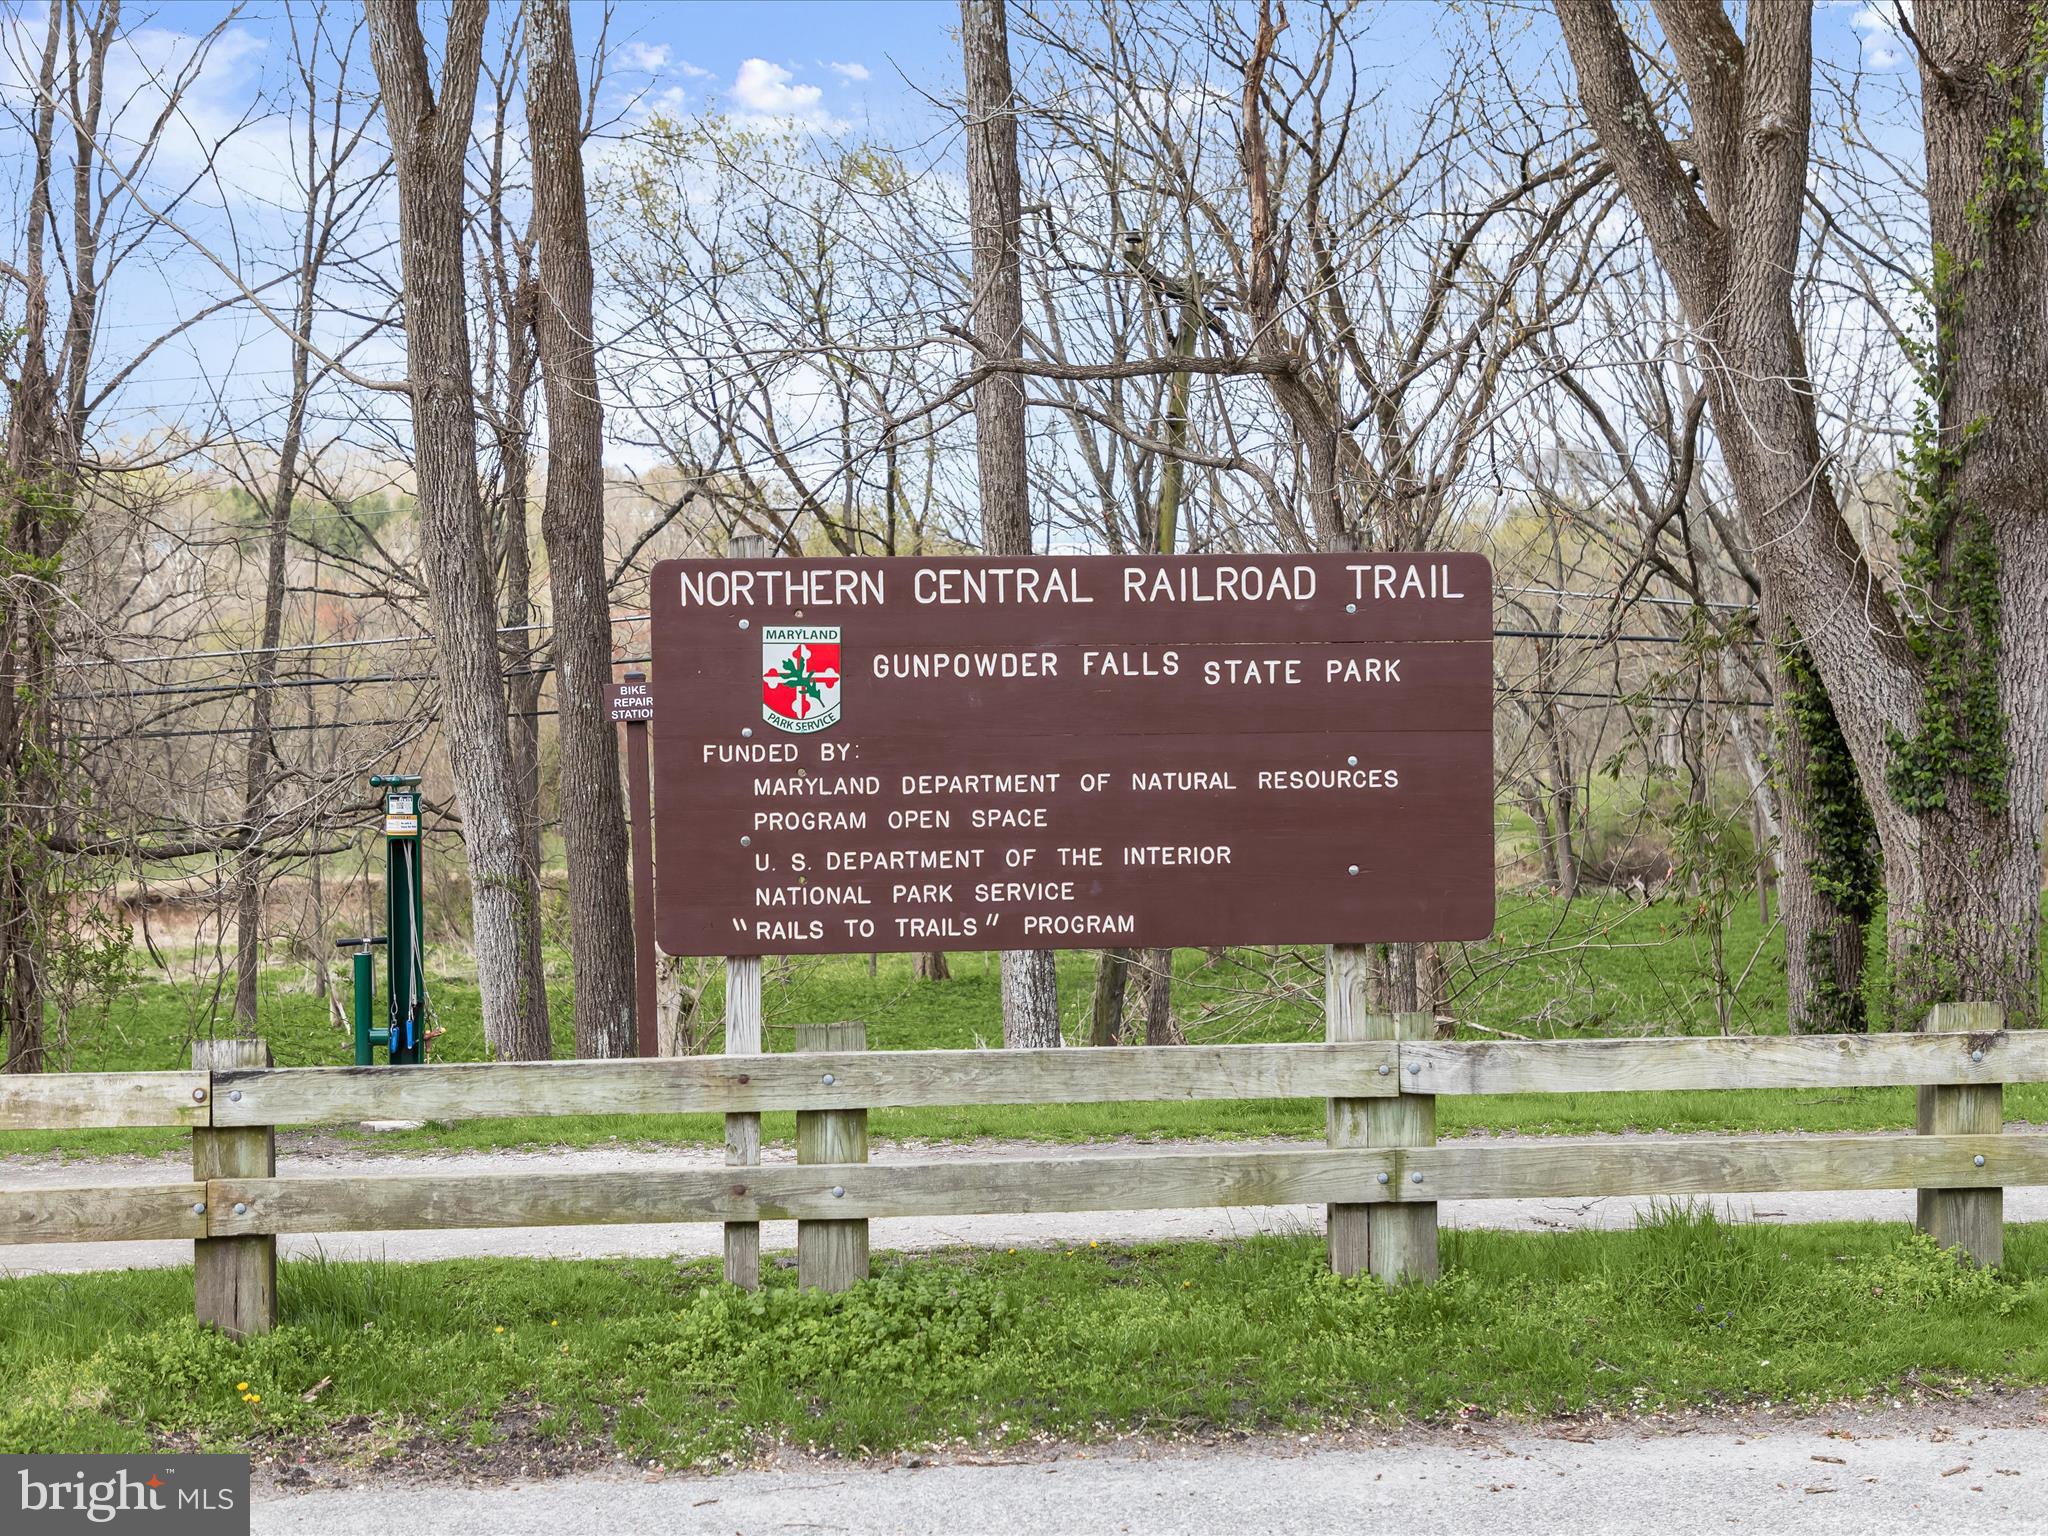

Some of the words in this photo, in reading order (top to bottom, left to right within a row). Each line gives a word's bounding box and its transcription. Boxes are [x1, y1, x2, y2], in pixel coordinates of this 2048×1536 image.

[680, 569, 884, 607] NORTHERN
[914, 567, 1094, 604] CENTRAL
[1124, 565, 1316, 603] RAILROAD
[1345, 564, 1465, 600] TRAIL
[766, 630, 838, 640] MARYLAND
[873, 652, 1058, 679] GUNPOWDER
[1083, 651, 1179, 676] FALLS
[1203, 659, 1302, 685] STATE
[1326, 658, 1401, 683] PARK
[620, 685, 647, 695] BIKE
[614, 697, 653, 707] REPAIR
[767, 713, 793, 730] PARK
[795, 713, 836, 731] SERVICE
[703, 743, 799, 763] FUNDED
[820, 742, 860, 762] BY:
[754, 773, 880, 796] MARYLAND
[902, 773, 1061, 795] DEPARTMENT
[1080, 773, 1111, 792] OF
[1132, 771, 1237, 791] NATURAL
[1258, 769, 1399, 790] RESOURCES
[754, 811, 867, 831] PROGRAM
[888, 810, 950, 830] OPEN
[971, 808, 1048, 828] SPACE
[755, 853, 776, 872] U.
[791, 853, 812, 872] S.
[826, 849, 985, 871] DEPARTMENT
[1005, 848, 1037, 868] OF
[1056, 847, 1103, 867] THE
[1124, 845, 1231, 866] INTERIOR
[755, 885, 872, 906] NATIONAL
[893, 884, 953, 904] PARK
[975, 881, 1075, 903] SERVICE
[843, 918, 875, 938] TO
[1024, 914, 1135, 935] PROGRAM
